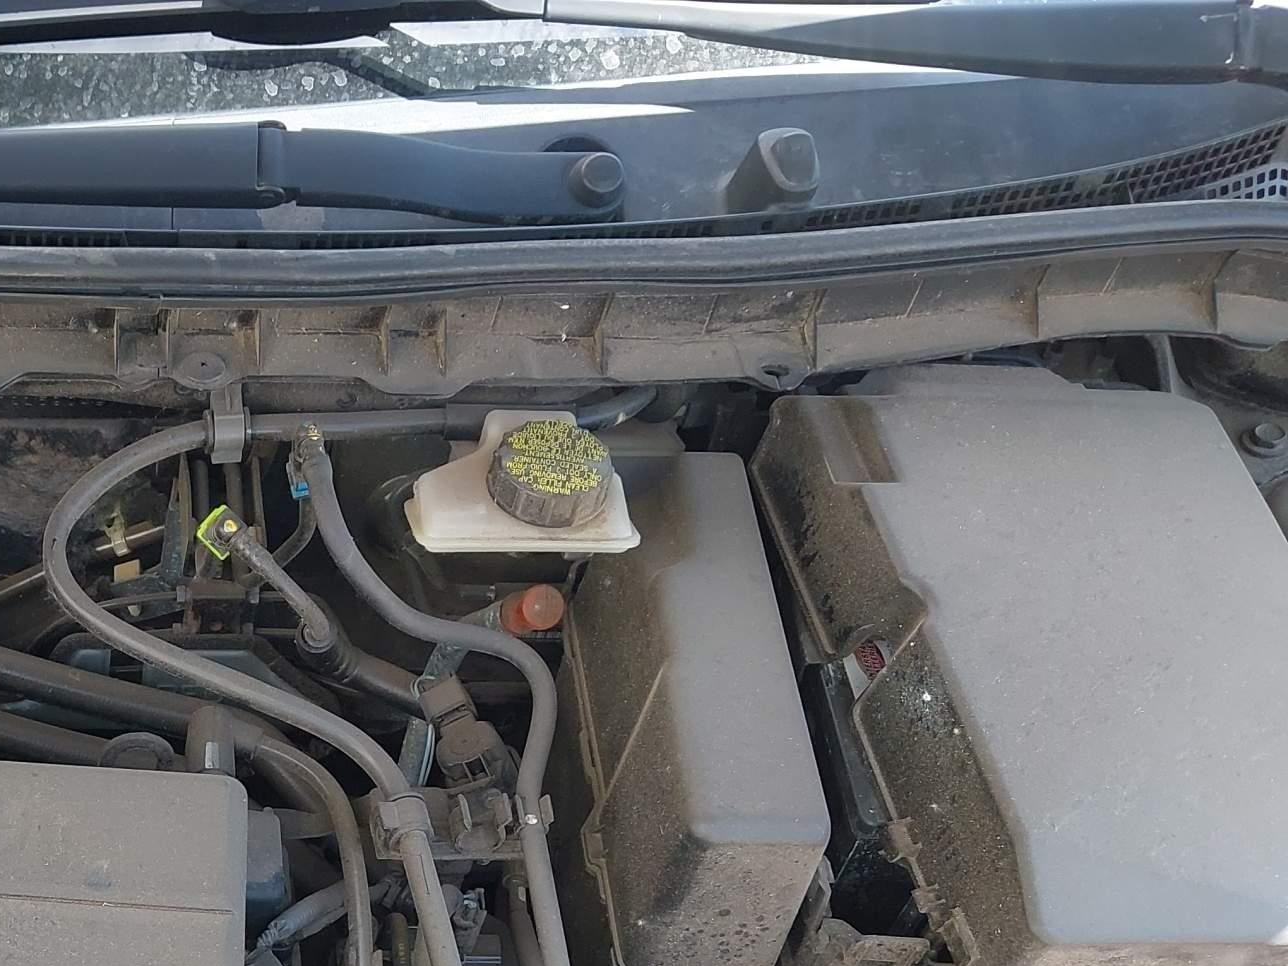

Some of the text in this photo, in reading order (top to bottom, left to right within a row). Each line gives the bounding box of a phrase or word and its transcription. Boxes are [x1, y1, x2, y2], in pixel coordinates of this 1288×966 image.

[506, 462, 527, 470] FROM
[559, 461, 588, 471] SEALED
[511, 468, 524, 476] USE
[584, 471, 601, 480] ONLY
[538, 478, 562, 488] FILLER
[571, 475, 597, 486] BEFORE
[566, 481, 589, 491] CLEAN
